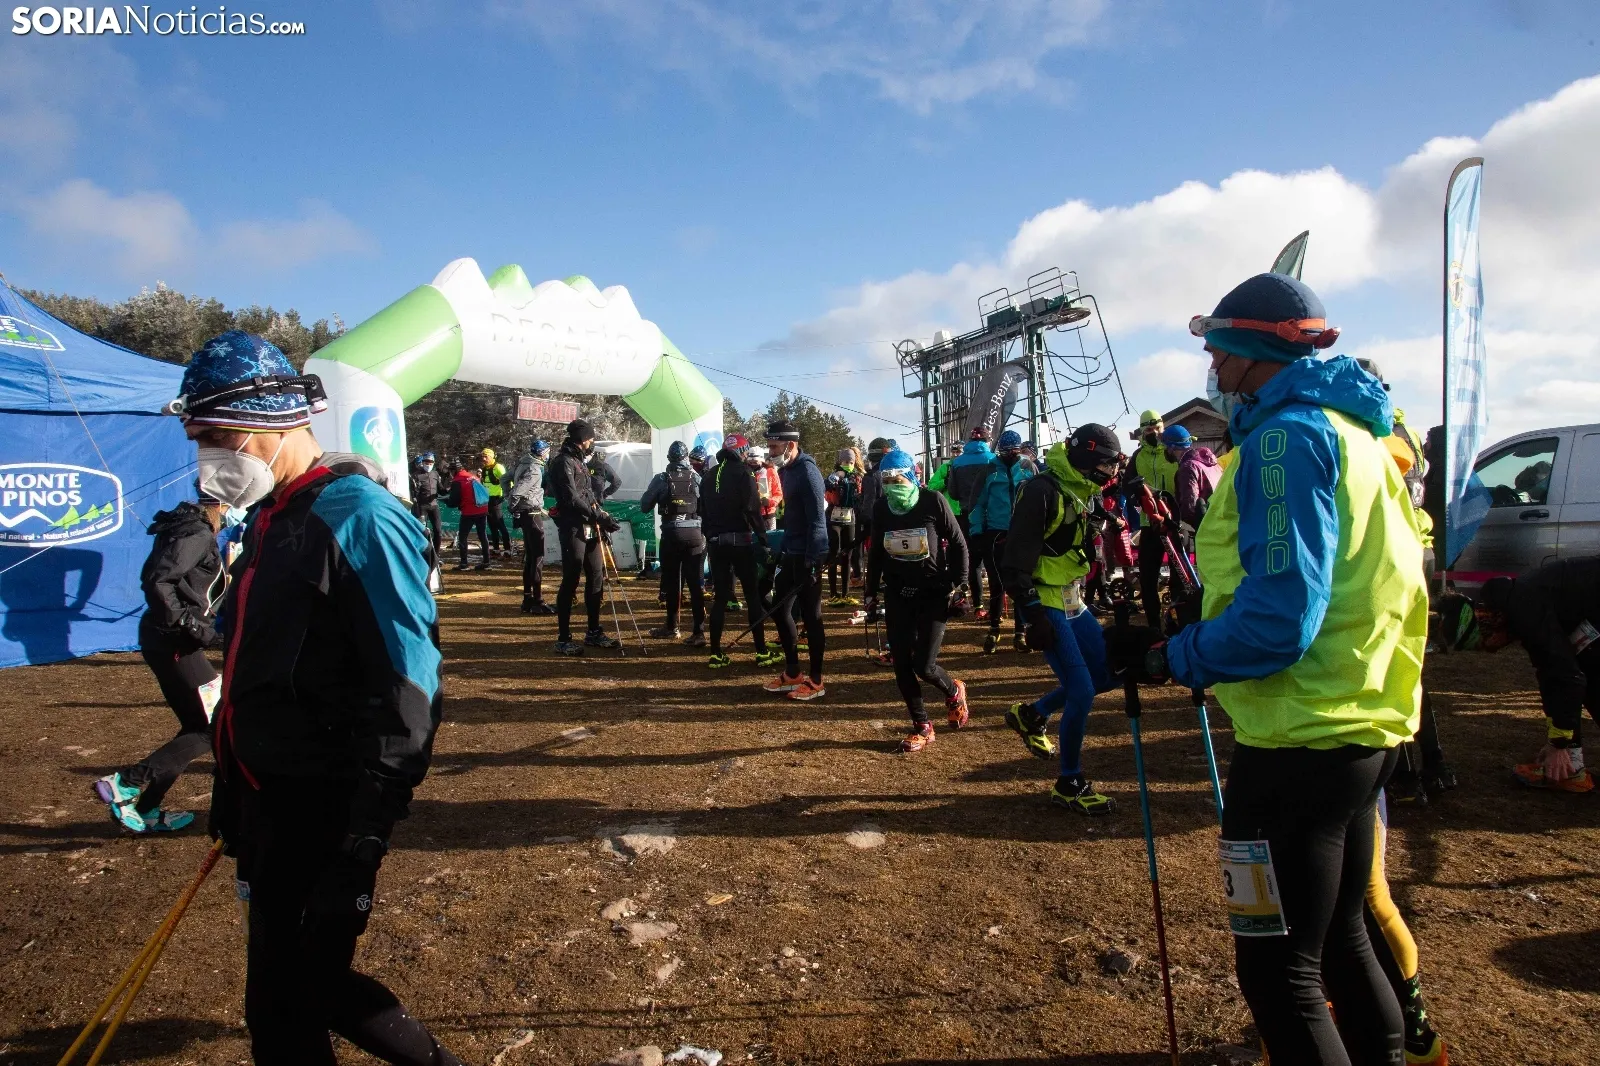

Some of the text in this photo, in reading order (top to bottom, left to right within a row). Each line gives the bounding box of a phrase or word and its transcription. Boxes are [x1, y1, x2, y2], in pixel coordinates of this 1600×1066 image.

[0, 473, 82, 489] MONTE
[3, 490, 83, 507] PINOS
[43, 531, 70, 541] Natural
[902, 540, 909, 550] 5
